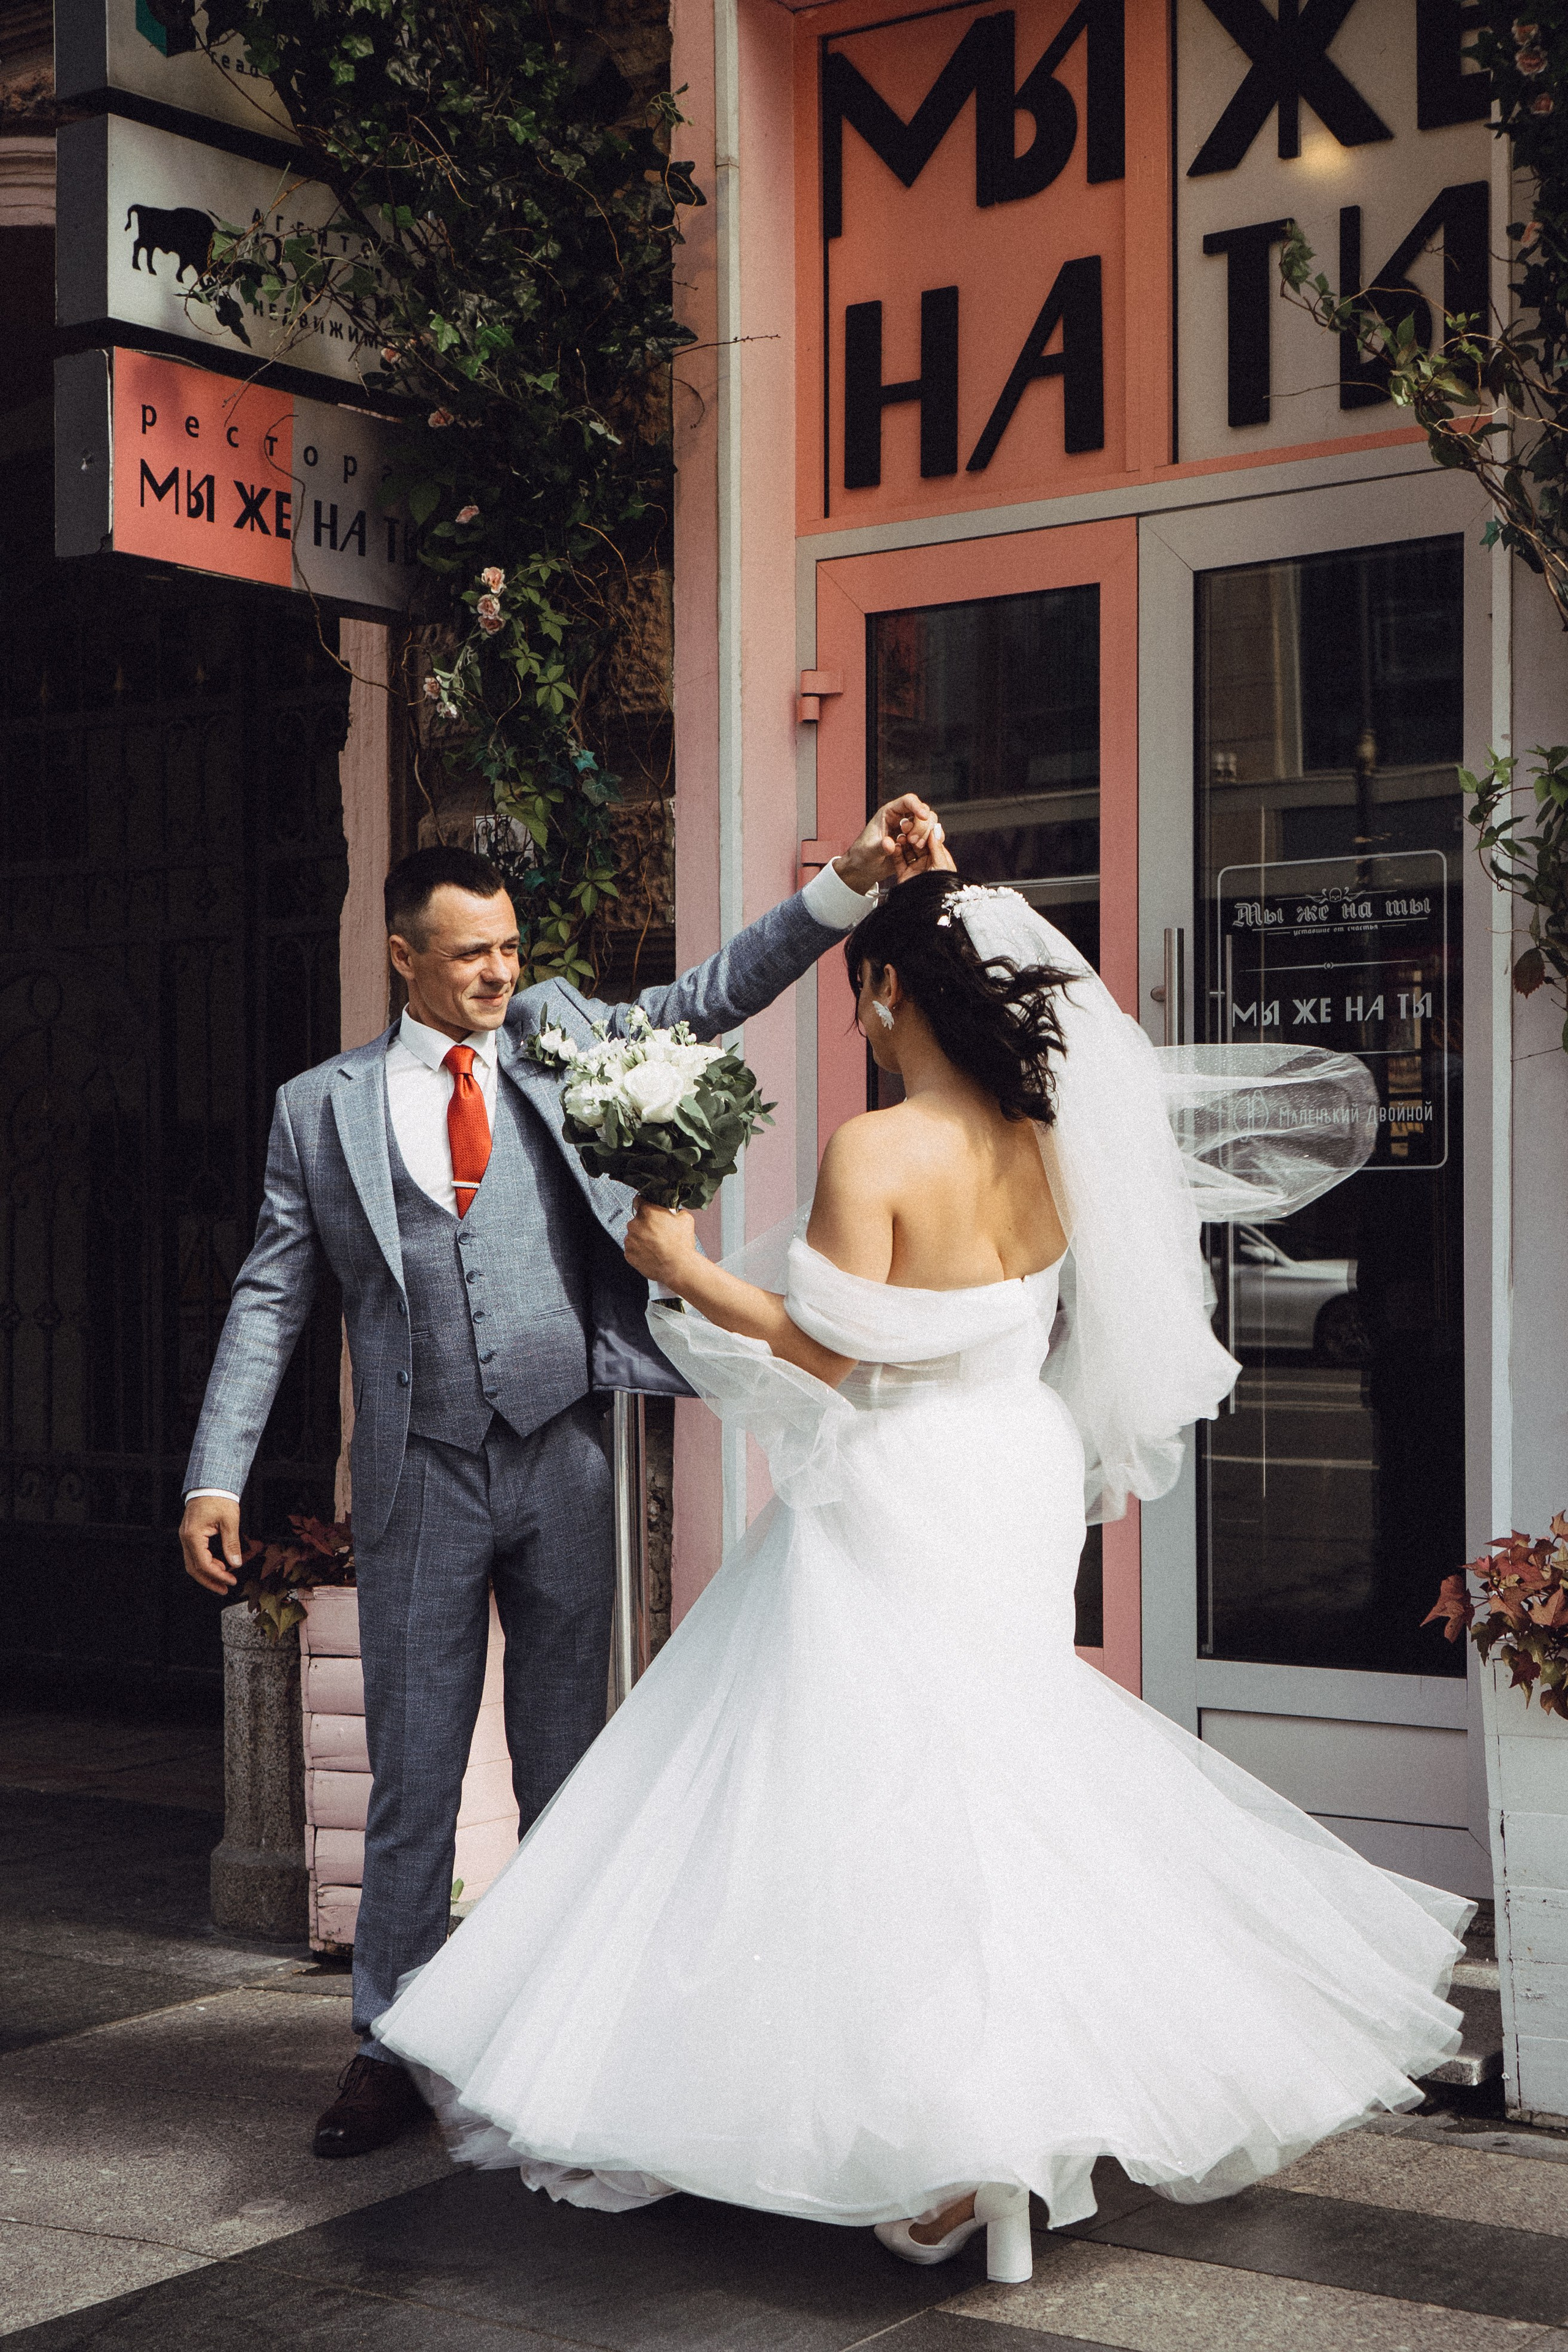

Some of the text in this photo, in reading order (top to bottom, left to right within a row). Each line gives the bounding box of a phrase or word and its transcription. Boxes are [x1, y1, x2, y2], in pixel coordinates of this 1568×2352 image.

[826, 0, 1493, 239] МЫ ЖЕ
[845, 179, 1491, 490] НА ТЫ
[140, 458, 215, 523] МЫ
[233, 480, 292, 540] ЖЕ
[313, 499, 366, 557] НА
[1232, 902, 1284, 927] Мы
[1342, 901, 1373, 919] на
[1385, 897, 1431, 916] ты
[1232, 992, 1432, 1027] МЫ ЖЕ НА ТЫ
